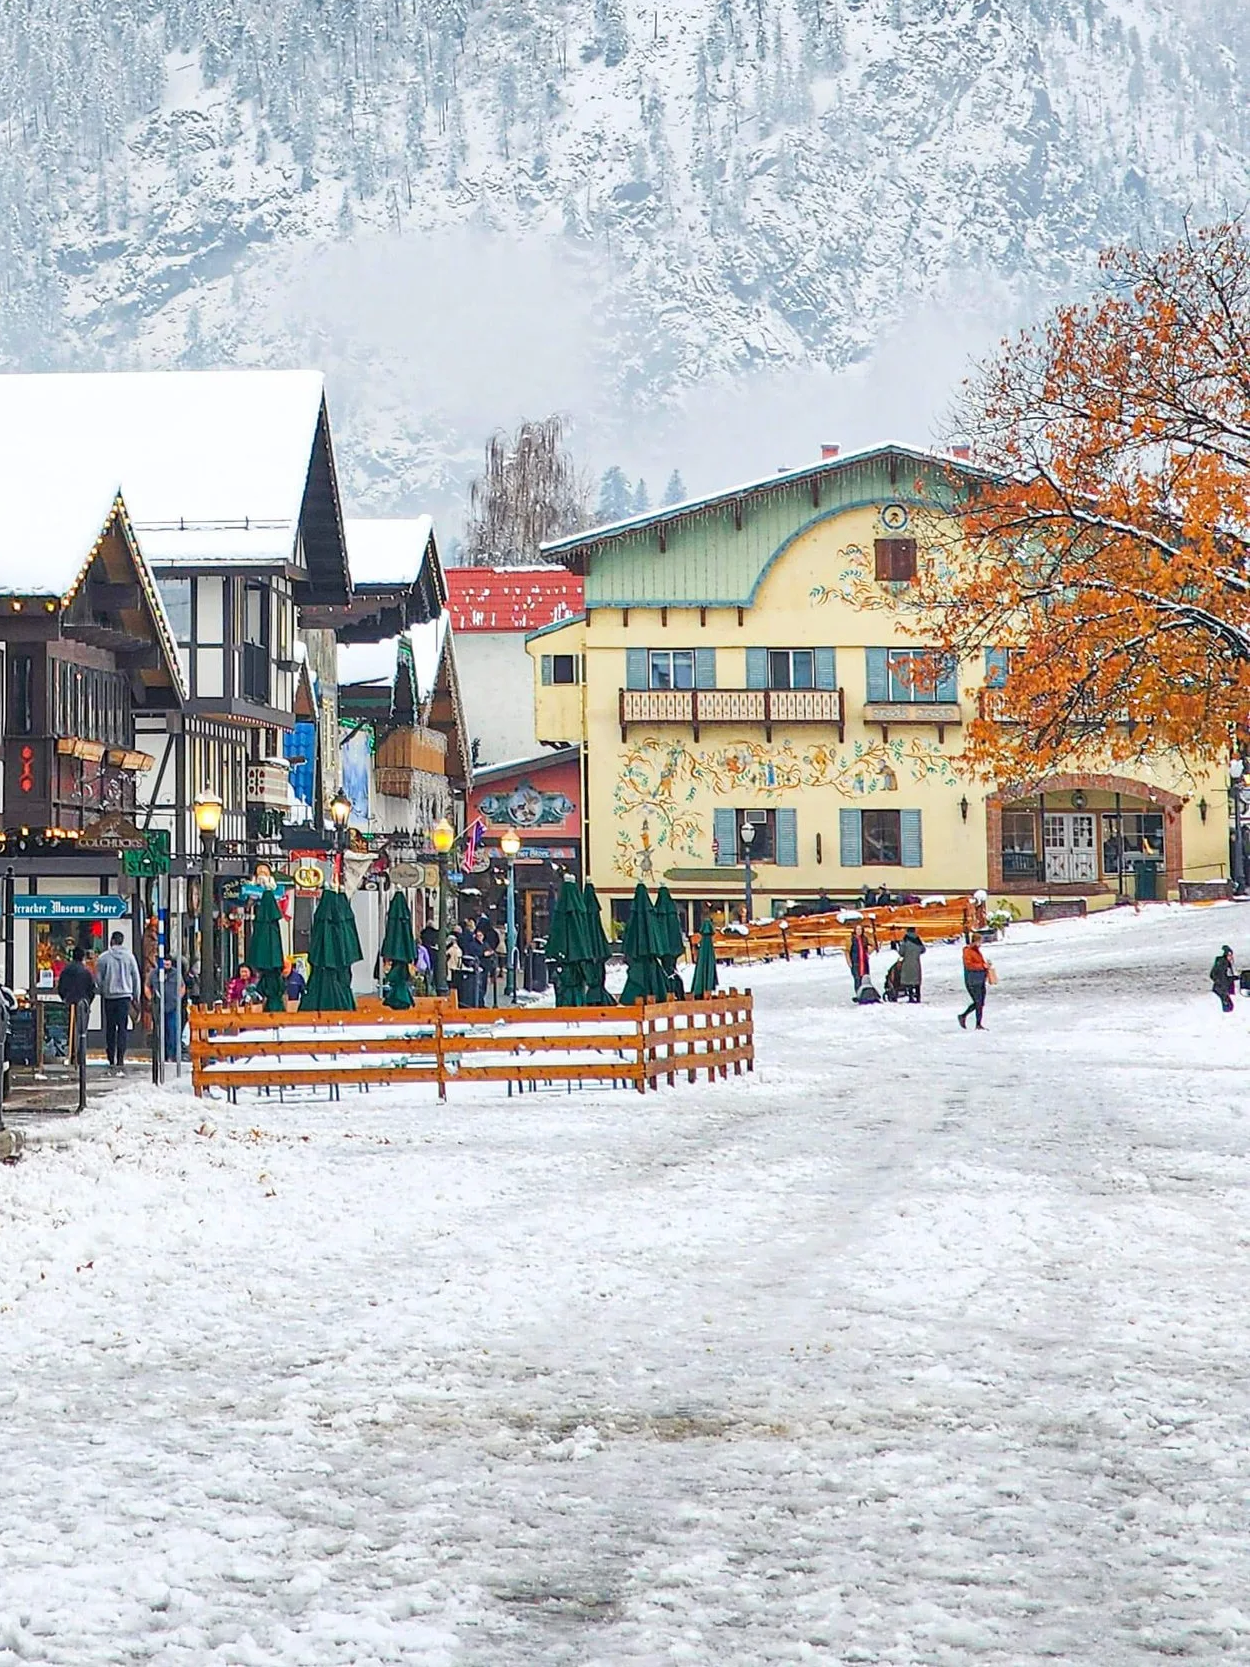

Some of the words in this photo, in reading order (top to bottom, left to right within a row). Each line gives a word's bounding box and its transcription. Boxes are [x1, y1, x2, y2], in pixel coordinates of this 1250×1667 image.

[127, 861, 167, 874] STEIN
[13, 902, 48, 914] tcracker
[50, 899, 86, 914] Museum
[92, 900, 118, 914] Store
